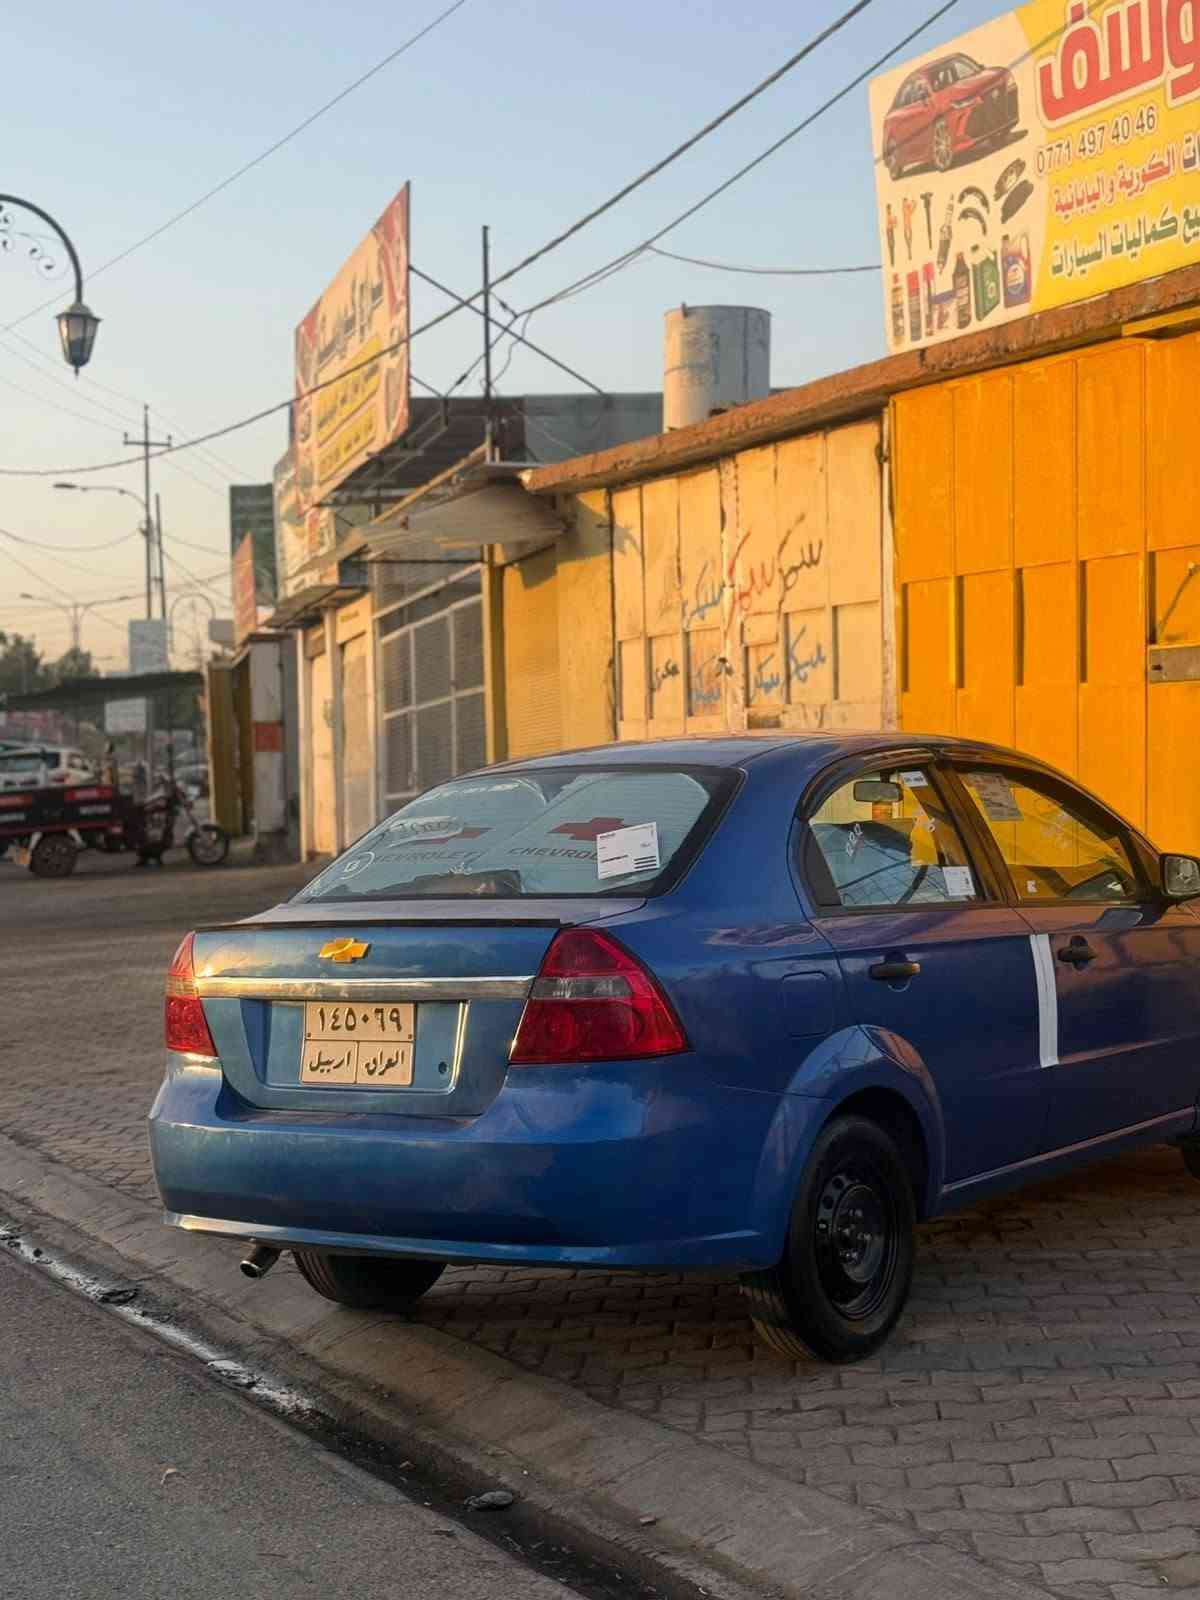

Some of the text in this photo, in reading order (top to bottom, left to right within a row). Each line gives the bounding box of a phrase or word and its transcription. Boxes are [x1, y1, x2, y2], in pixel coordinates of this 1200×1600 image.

[1037, 106, 1156, 173] 0771 497 40 46
[1118, 150, 1176, 197] الكورية
[1052, 231, 1107, 276] السيارات
[1111, 206, 1177, 258] كماليات
[318, 1007, 402, 1032] ١٤٥٠٦٩
[309, 1050, 351, 1072] اربيل
